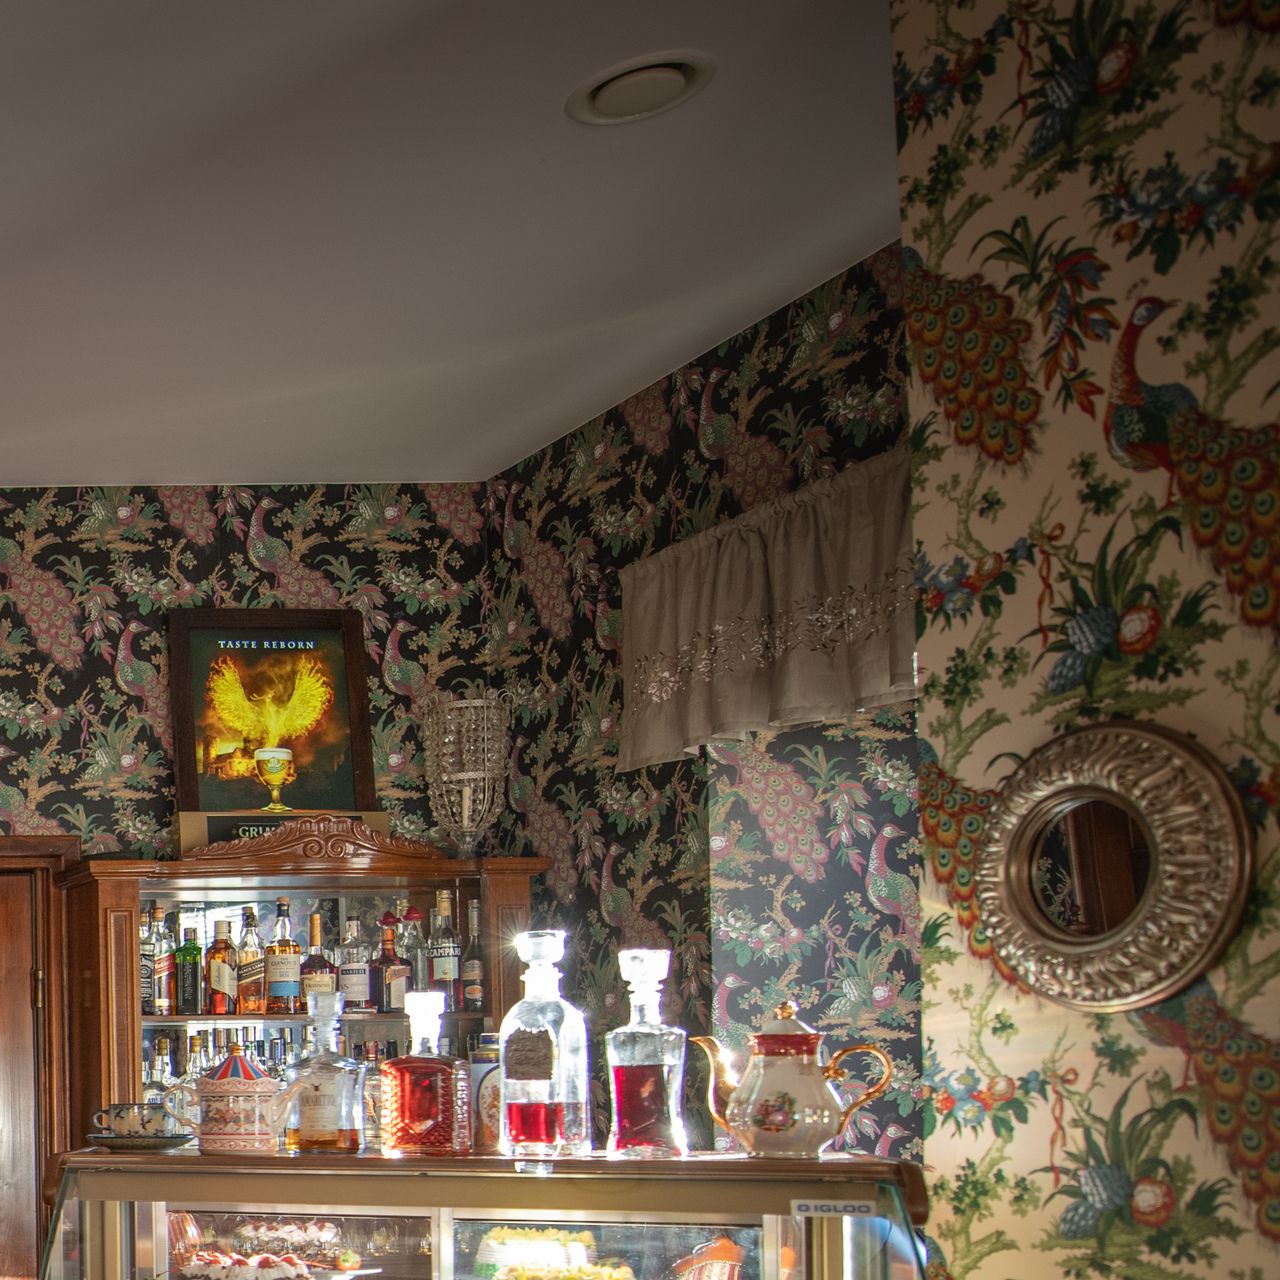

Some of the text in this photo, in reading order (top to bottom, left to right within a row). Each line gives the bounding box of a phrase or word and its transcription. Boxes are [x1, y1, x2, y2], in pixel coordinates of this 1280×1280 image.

[218, 640, 315, 649] TASTE REBORN
[239, 826, 276, 838] GRIM
[430, 946, 461, 957] CAMPARI
[814, 1204, 871, 1214] IGLOO
